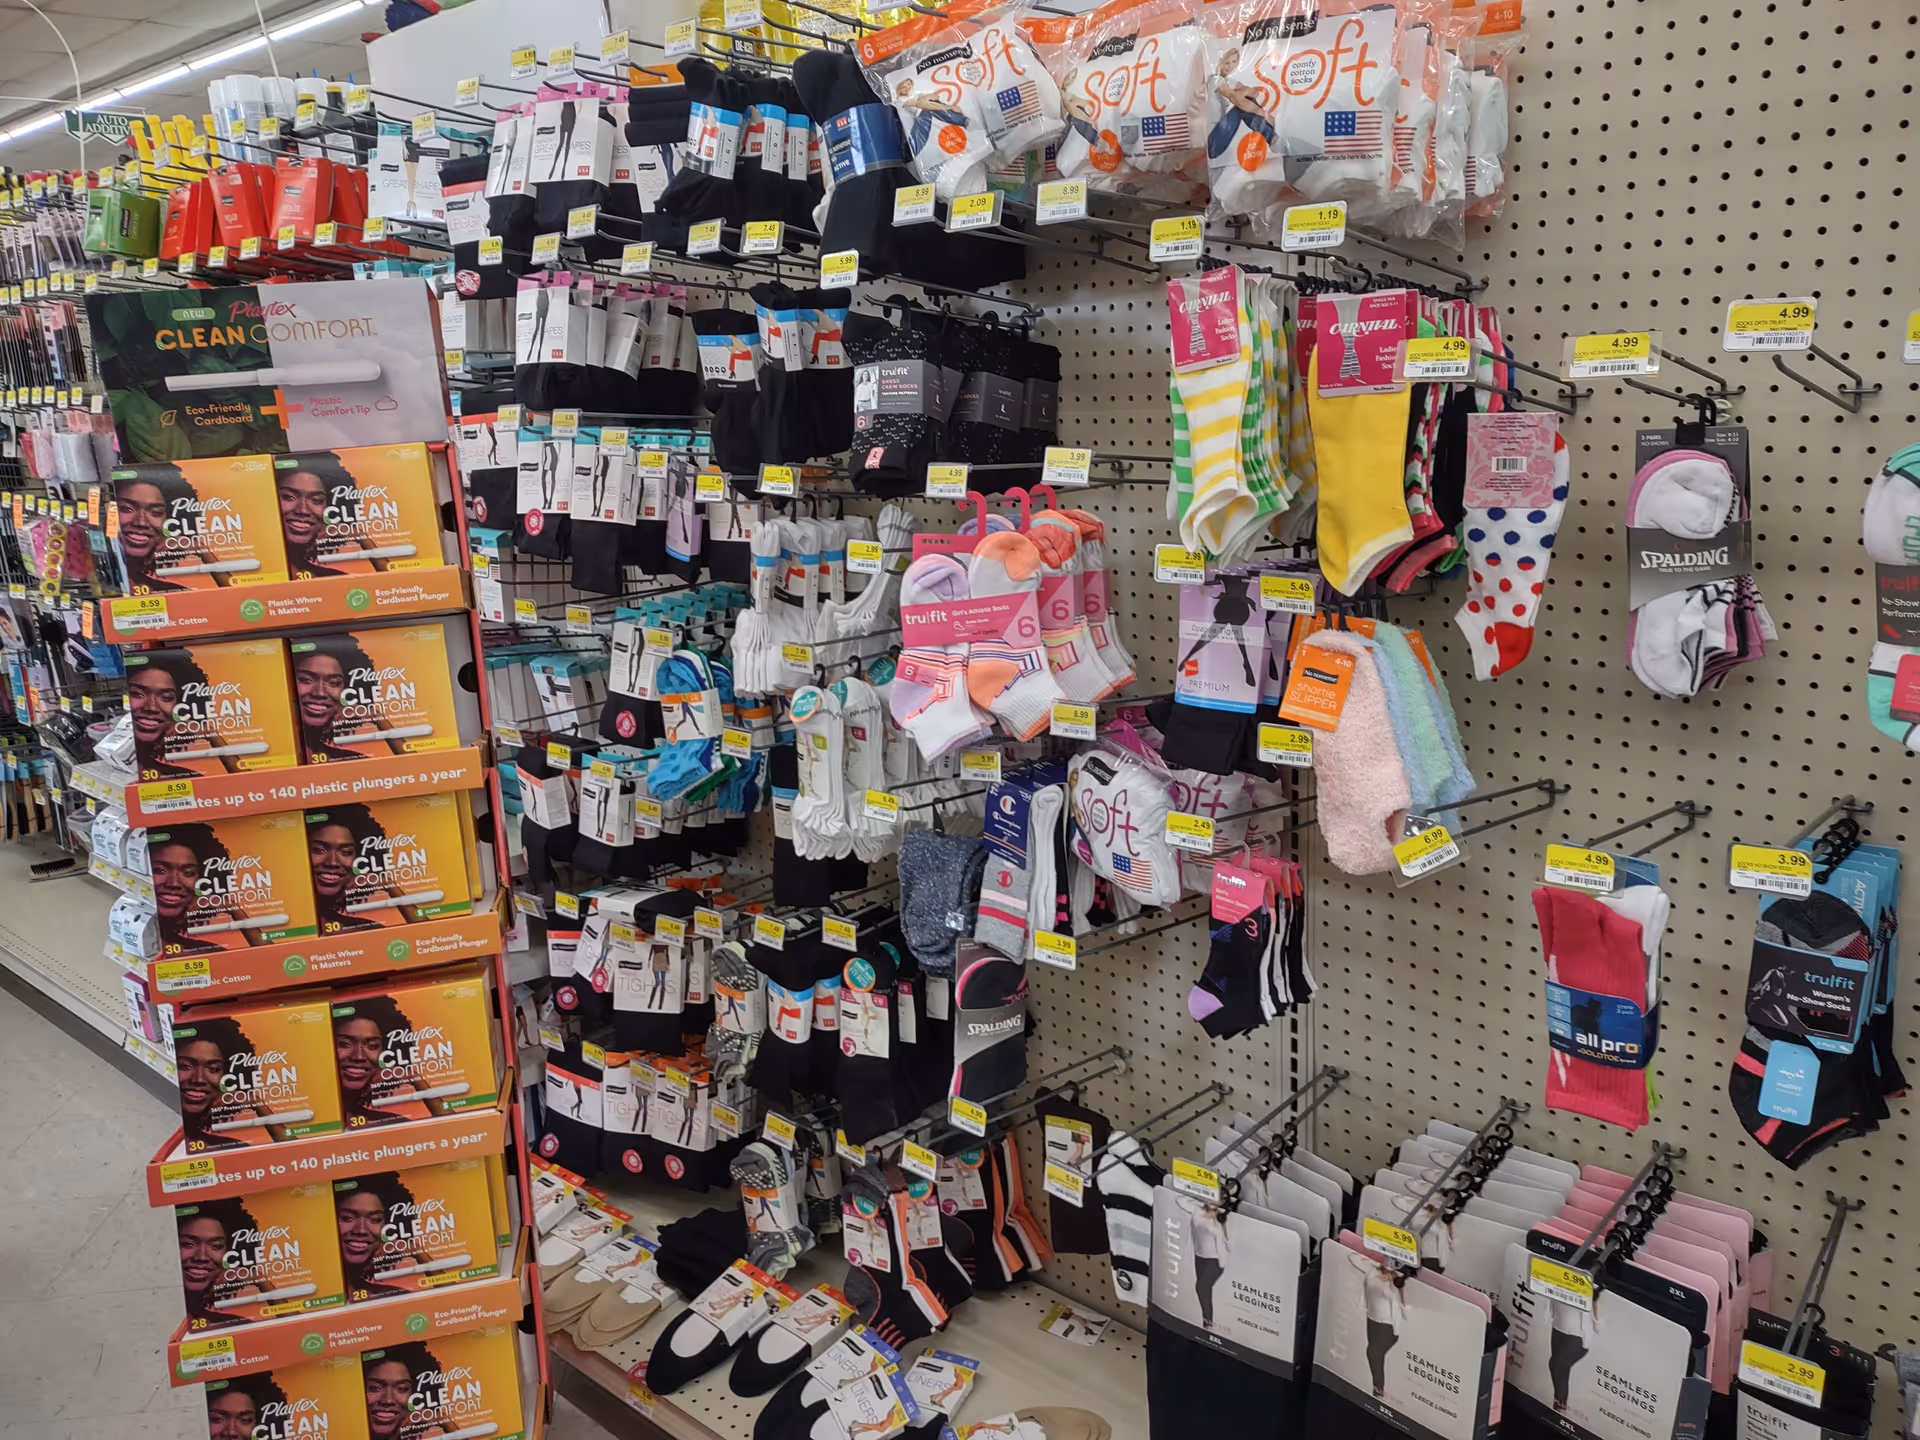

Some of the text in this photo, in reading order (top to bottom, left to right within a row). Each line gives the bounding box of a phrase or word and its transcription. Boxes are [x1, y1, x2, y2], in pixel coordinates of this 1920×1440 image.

[1494, 8, 1514, 21] 4-10
[1246, 21, 1315, 38] No nonsense
[864, 43, 875, 58] 6
[931, 28, 1026, 106] Soft
[1254, 18, 1377, 113] Soft
[1292, 60, 1316, 69] comfy
[1085, 38, 1166, 121] Soft
[1290, 77, 1312, 85] socks
[97, 115, 128, 126] AUTO
[86, 123, 130, 135] ADDITIV
[915, 187, 929, 197] 8.99
[1062, 185, 1079, 195] 8.99
[969, 197, 986, 207] 2.09
[1318, 209, 1338, 220] 1.19
[763, 224, 776, 232] 7.49
[1180, 220, 1197, 230] 1.19
[839, 256, 853, 265] 5.99
[182, 309, 205, 319] NEW
[228, 301, 296, 323] Playtex
[1779, 307, 1809, 318] 4.99
[156, 317, 373, 350] CLEAN COMFORT
[1215, 325, 1235, 334] Fashion
[1329, 319, 1398, 337] CARNIVAL
[1443, 341, 1466, 351] 4.99
[1612, 337, 1638, 347] 4.99
[309, 395, 342, 405] Plastic
[185, 403, 251, 415] Eco-Friendly
[312, 405, 370, 417] Comfort Tip
[194, 413, 253, 426] Cardboard
[857, 416, 866, 428] 6
[949, 469, 962, 477] 4.99
[330, 485, 388, 507] Playtex
[171, 496, 231, 521] Playtex
[323, 501, 399, 524] CLEAN
[162, 514, 242, 537] CLEAN
[325, 518, 399, 537] COMFORT
[165, 531, 243, 550] COMFORT
[865, 545, 879, 553] 2.99
[1185, 552, 1201, 560] 2.99
[1641, 546, 1728, 569] SPALDING
[133, 585, 149, 596] 30
[375, 585, 423, 597] Eco-Friendly
[1291, 582, 1310, 592] 5.49
[140, 599, 160, 609] 8.59
[268, 595, 323, 608] Plastic Where
[376, 591, 450, 605] Cardboard Plunger
[1084, 593, 1101, 614] 6
[1881, 597, 1920, 607] No-Show
[269, 604, 310, 615] It Matters
[969, 606, 991, 615] Athletic
[993, 604, 1009, 612] Socks
[1051, 599, 1070, 620] 6
[1882, 608, 1920, 619] Performa
[179, 615, 208, 626] Cotton
[1018, 616, 1036, 638] 6
[1335, 658, 1352, 667] 4-10
[904, 666, 914, 675] 6
[1304, 669, 1338, 683] No nonsense
[181, 681, 242, 702] Playtex
[1190, 680, 1230, 692] PREMIUM
[1297, 682, 1336, 698] shortie
[1290, 691, 1337, 710] SLIPPER
[172, 698, 251, 722] CLEAN
[1073, 709, 1089, 719] 8.99
[174, 714, 252, 734] COMFORT
[1289, 734, 1309, 744] 2.99
[981, 755, 997, 764] 5.99
[142, 769, 159, 780] 30
[168, 783, 187, 793] 8.59
[222, 792, 244, 810] up
[248, 791, 264, 802] to
[269, 786, 296, 800] 140
[301, 780, 349, 802] plastic
[352, 774, 415, 794] plungers
[419, 773, 427, 782] a
[1193, 820, 1211, 830] 2.49
[1423, 828, 1444, 845] 6.99
[360, 833, 417, 854] Playtex
[352, 850, 427, 875] CLEAN
[1585, 854, 1608, 865] 4.99
[1778, 854, 1805, 866] 3.99
[354, 865, 427, 885] COMFORT
[1855, 879, 1866, 918] ACTIV
[325, 922, 340, 932] 30
[1245, 917, 1258, 937] 3
[1057, 939, 1071, 948] 3.99
[185, 961, 204, 970] 8.59
[618, 977, 676, 994] TIGHS
[1786, 992, 1851, 1012] No-Show Socks
[1812, 989, 1851, 1002] Women's
[967, 1014, 1022, 1036] SPALDING
[1576, 1032, 1639, 1053] all pro
[970, 1107, 983, 1119] 4.99
[921, 1150, 933, 1161] 5.99
[189, 1161, 208, 1170] 8.59
[1065, 1173, 1080, 1185] 5.99
[1196, 1169, 1214, 1181] 5.99
[389, 1199, 446, 1223] Playtex
[381, 1214, 455, 1241] CLEAN
[383, 1230, 455, 1254] COMFORT
[1392, 1230, 1413, 1245] 5.99
[1563, 1272, 1585, 1286] 5.99
[353, 1289, 368, 1301] 28
[1231, 1279, 1281, 1304] SEAMLESS
[1669, 1287, 1686, 1299] 2XL
[1233, 1292, 1281, 1314] LEGGINGS
[1237, 1316, 1280, 1337] FLEECE LINING
[208, 1340, 228, 1349] 8.59
[1829, 1345, 1841, 1356] 3
[1405, 1351, 1462, 1384] SEAMLESS
[1788, 1363, 1814, 1379] 2.99
[416, 1367, 472, 1391] Playtex
[906, 1371, 951, 1392] LINERS
[1407, 1363, 1460, 1396] LEGGINGS
[1596, 1365, 1657, 1403] SEAMLESS
[408, 1381, 481, 1411] CLEAN
[1597, 1378, 1656, 1414] LEGGINGS
[261, 1398, 320, 1423] Playtex
[409, 1398, 481, 1423] COMFORT
[850, 1384, 879, 1425] LINERS
[1410, 1391, 1458, 1420] FLEECE LINING
[252, 1413, 329, 1440] CLEAN
[1559, 1419, 1576, 1433] 2XL
[1599, 1408, 1652, 1438] FLEECE LINING
